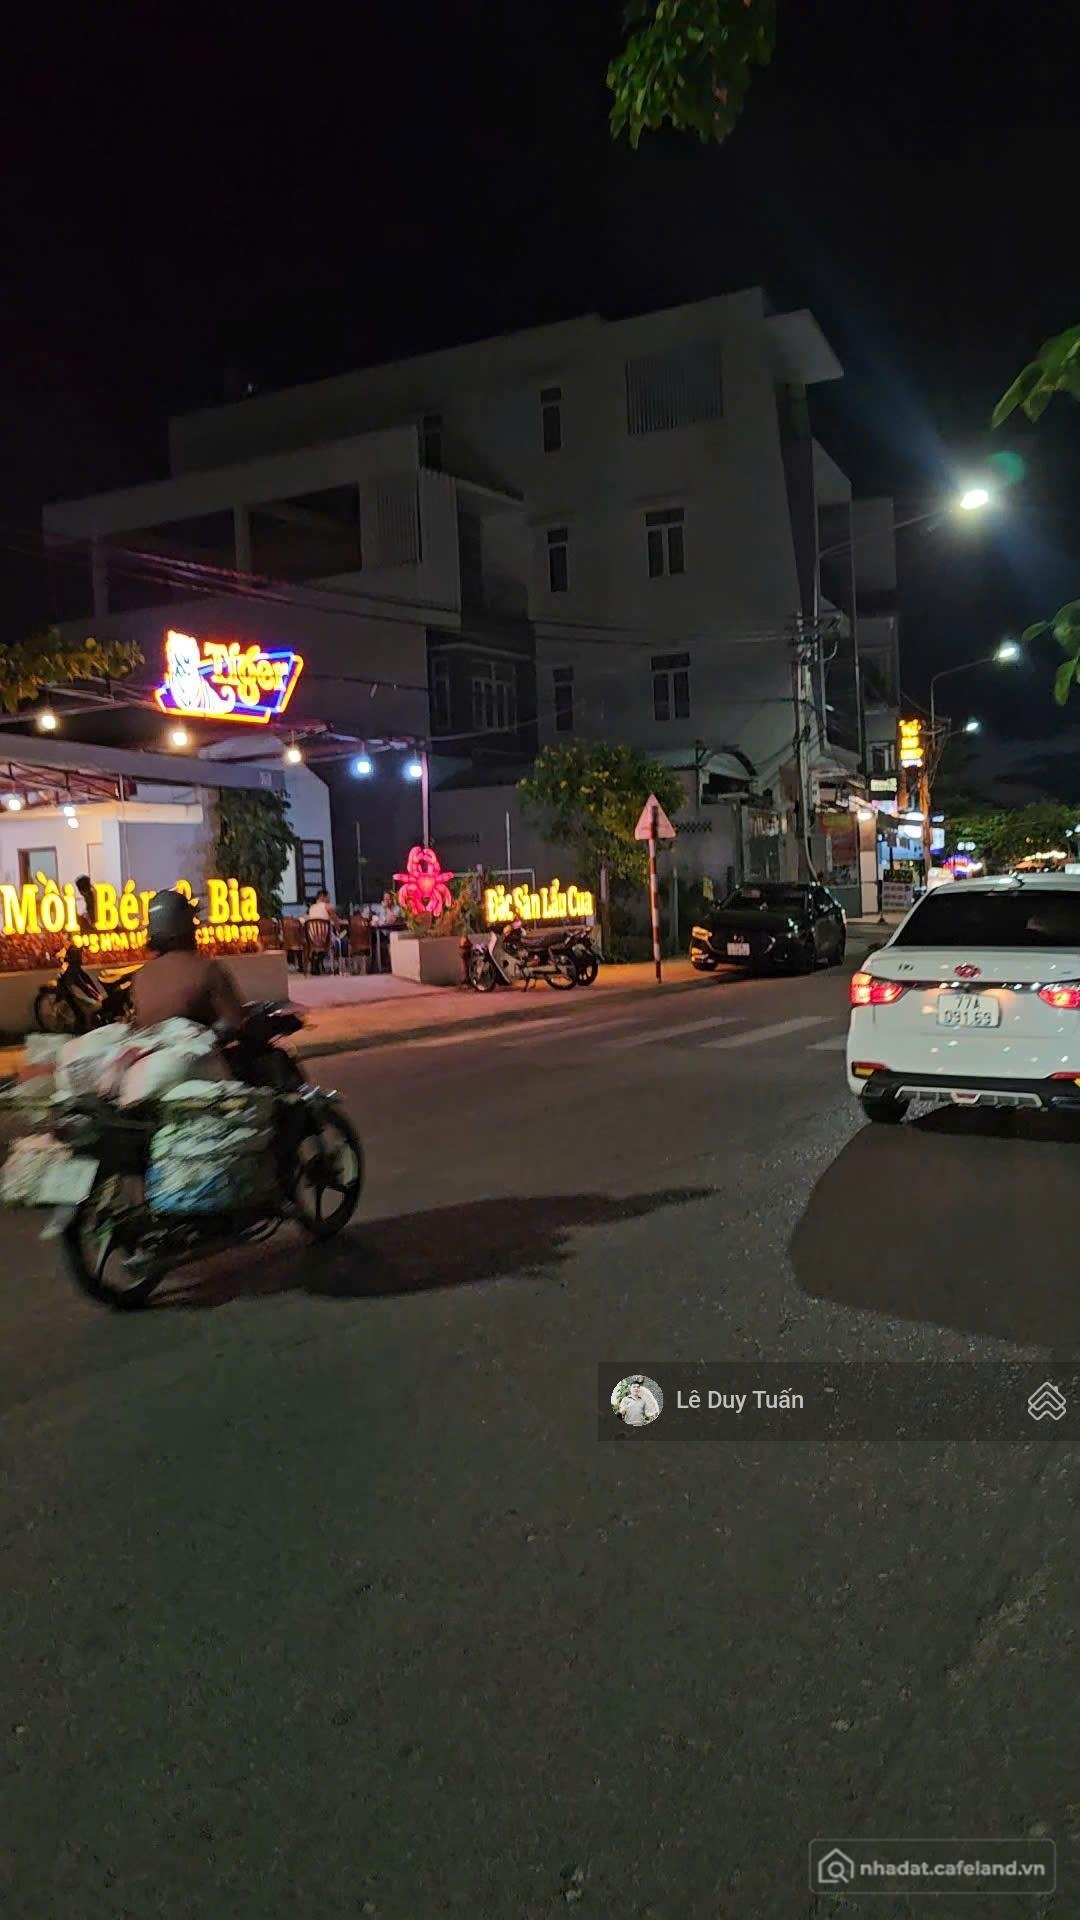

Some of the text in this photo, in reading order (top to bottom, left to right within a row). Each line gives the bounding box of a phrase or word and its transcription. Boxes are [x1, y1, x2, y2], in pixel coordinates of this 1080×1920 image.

[203, 642, 288, 706] Tiger
[207, 878, 260, 924] Bia
[567, 885, 593, 917] Cua
[957, 995, 980, 1009] 77A
